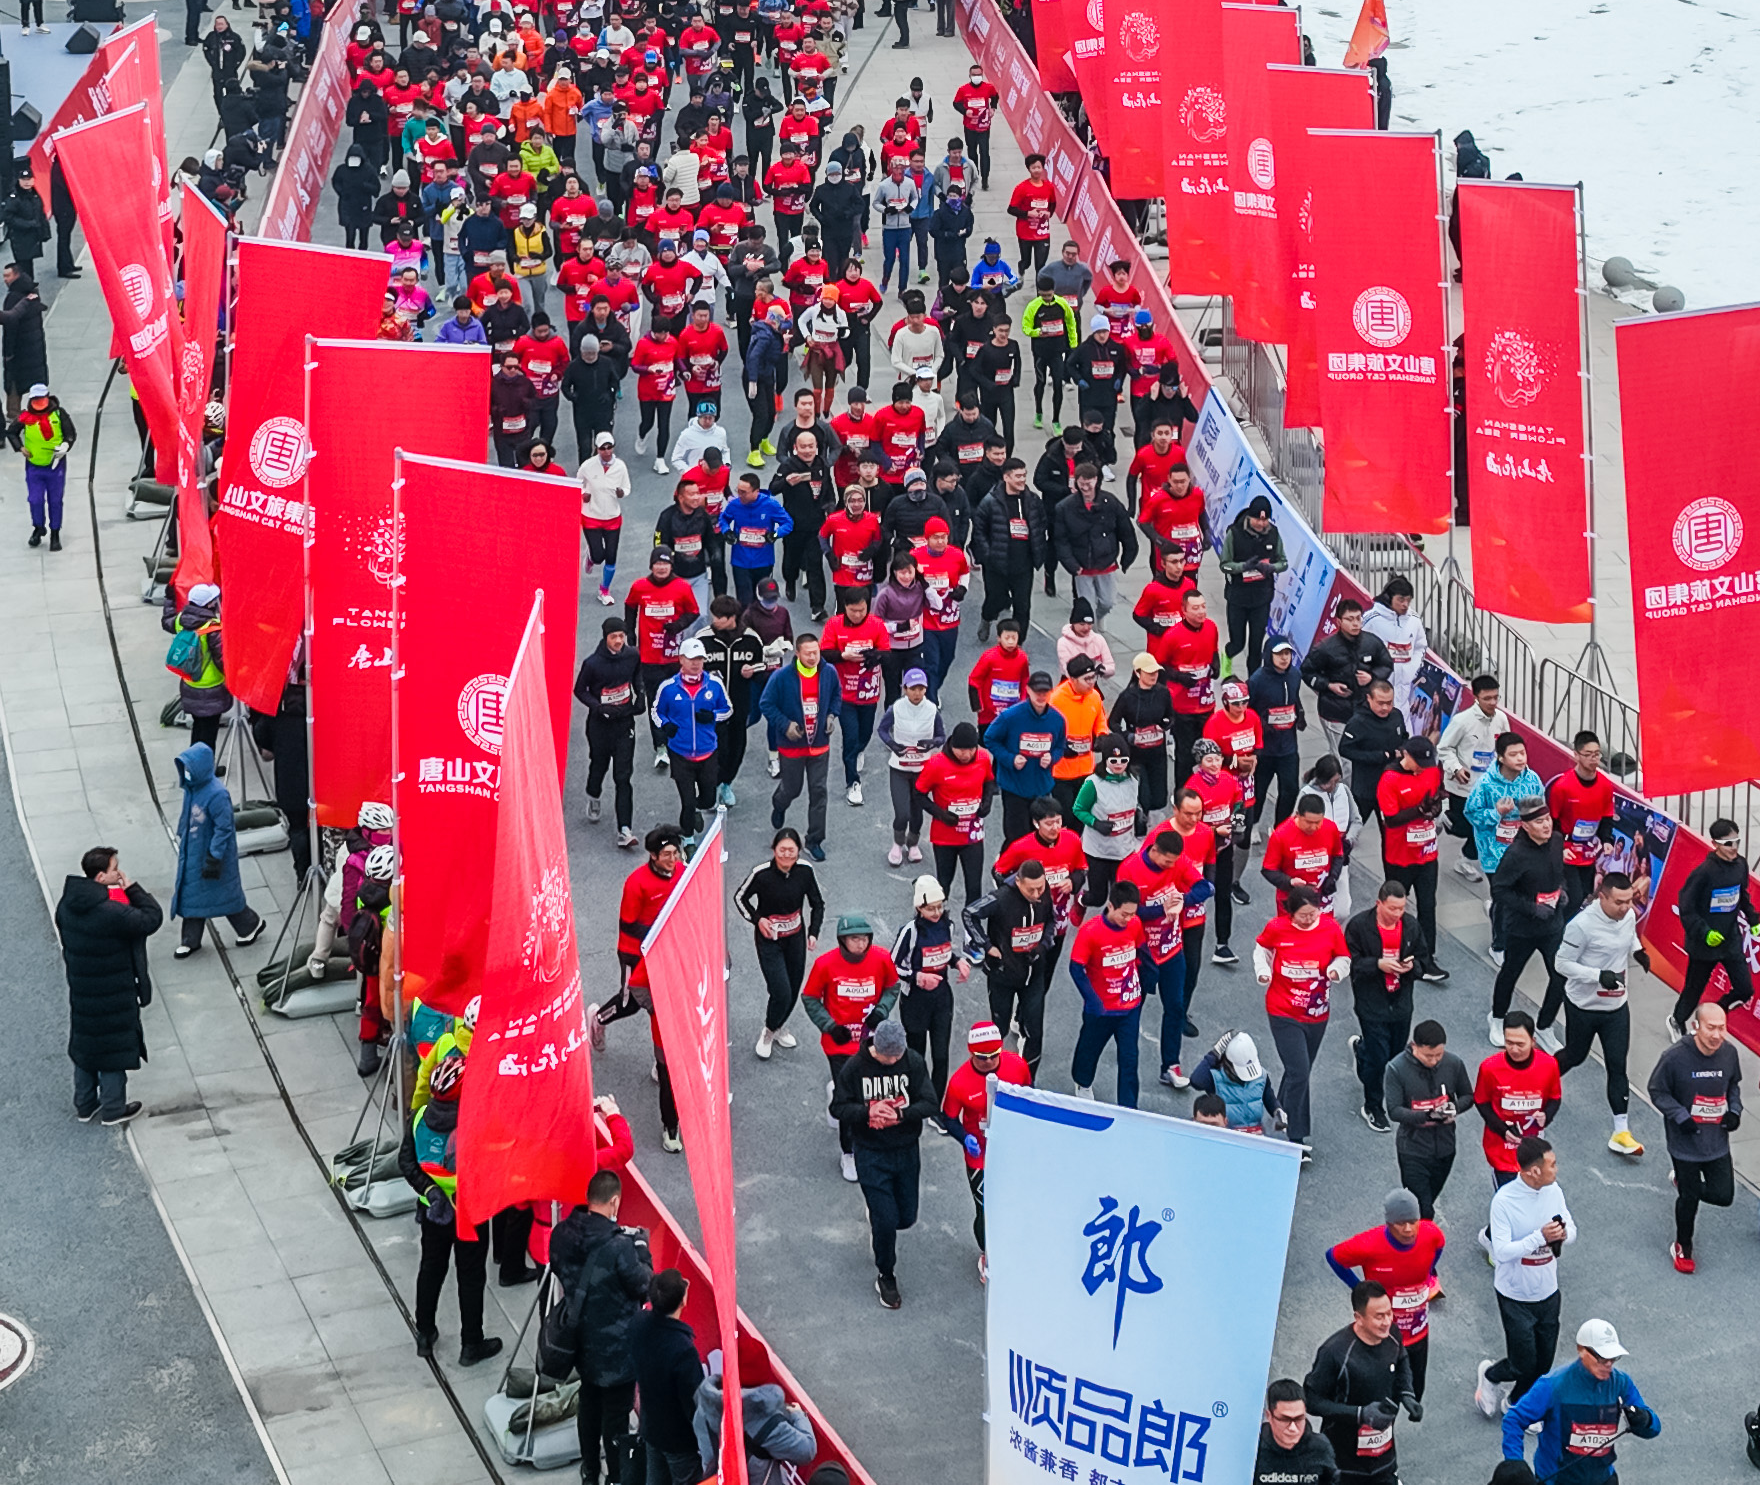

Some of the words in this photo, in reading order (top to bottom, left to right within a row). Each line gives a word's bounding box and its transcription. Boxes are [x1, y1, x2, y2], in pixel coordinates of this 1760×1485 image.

[219, 505, 259, 523] ANGSHAN
[418, 757, 501, 788] 唐山文
[418, 783, 491, 799] TANGSHAN
[1008, 1348, 1212, 1485] 顺品郎
[1009, 1426, 1079, 1482] 浓酱兼香
[1259, 1473, 1298, 1483] adidas
